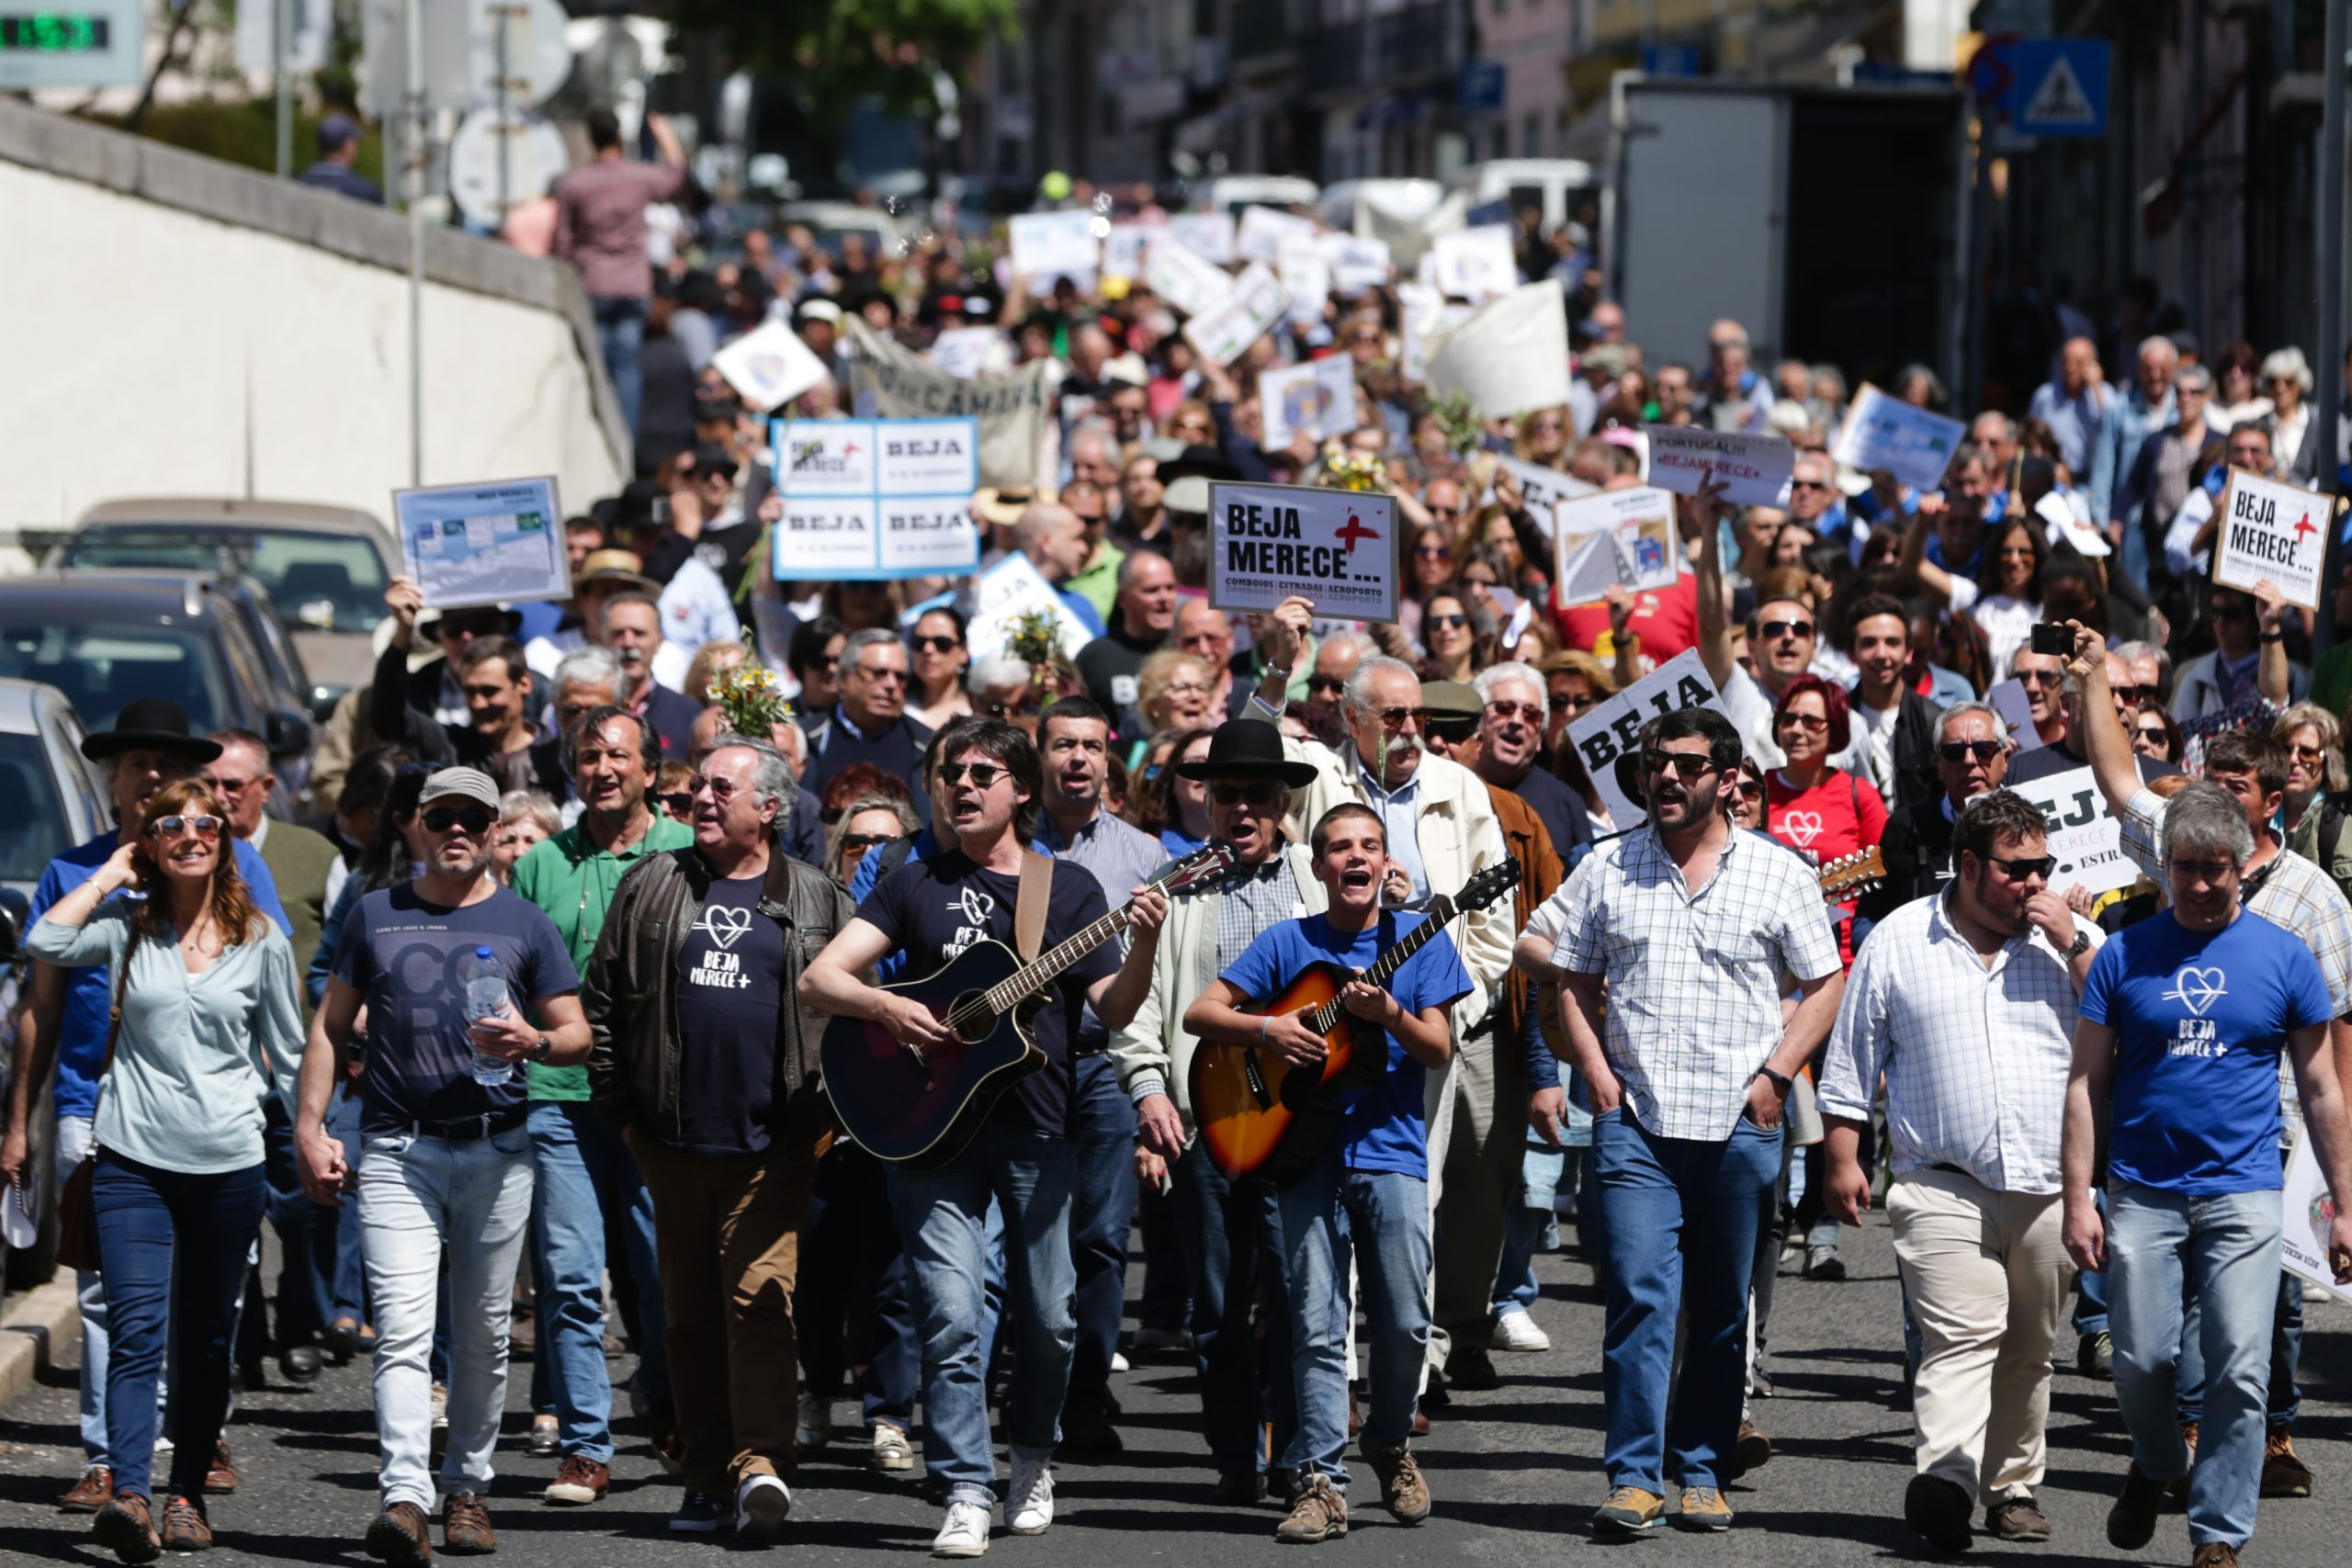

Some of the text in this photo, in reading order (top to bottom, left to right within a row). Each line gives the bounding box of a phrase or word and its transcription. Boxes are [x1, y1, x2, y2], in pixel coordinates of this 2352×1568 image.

[886, 441, 962, 457] BEJA
[2234, 490, 2277, 527] BEJA
[789, 515, 865, 531] BEJA
[890, 513, 964, 531] BEJA
[1227, 503, 1302, 540] BEJA
[1225, 577, 1383, 597] COMBOIOS ESTRADAS AEROPORTO
[703, 950, 741, 973] BEJA
[2178, 1019, 2217, 1040] BEJA
